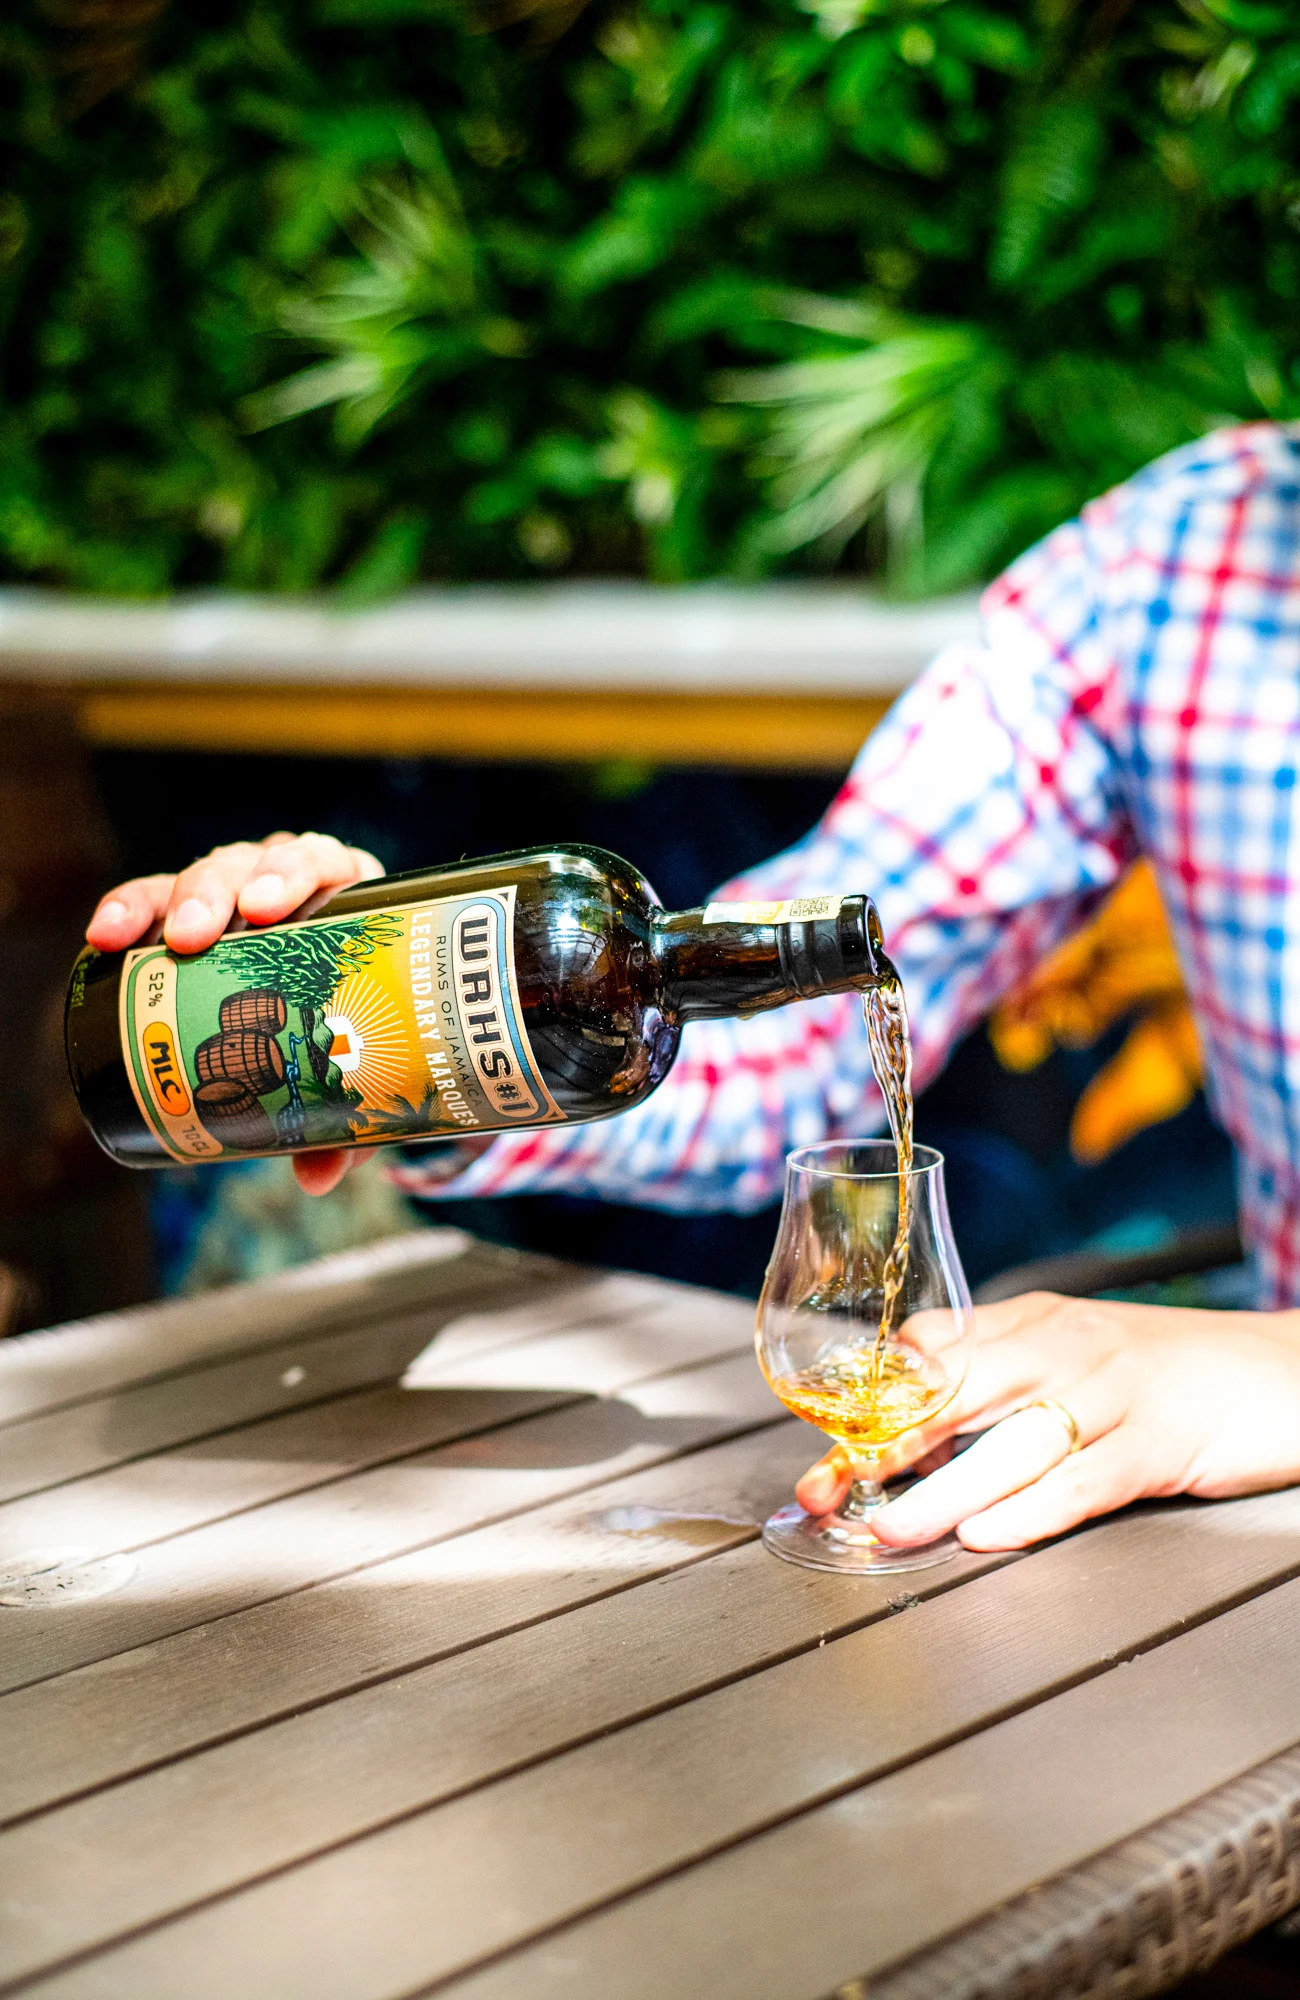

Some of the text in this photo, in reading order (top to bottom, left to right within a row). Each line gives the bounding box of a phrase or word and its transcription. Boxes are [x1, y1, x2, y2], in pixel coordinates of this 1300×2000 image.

[148, 972, 164, 1007] 52%
[409, 911, 480, 1126] LEGENDARY MARQUES
[436, 935, 480, 1107] RUMS OF JAMAICA
[149, 1041, 181, 1103] MLC
